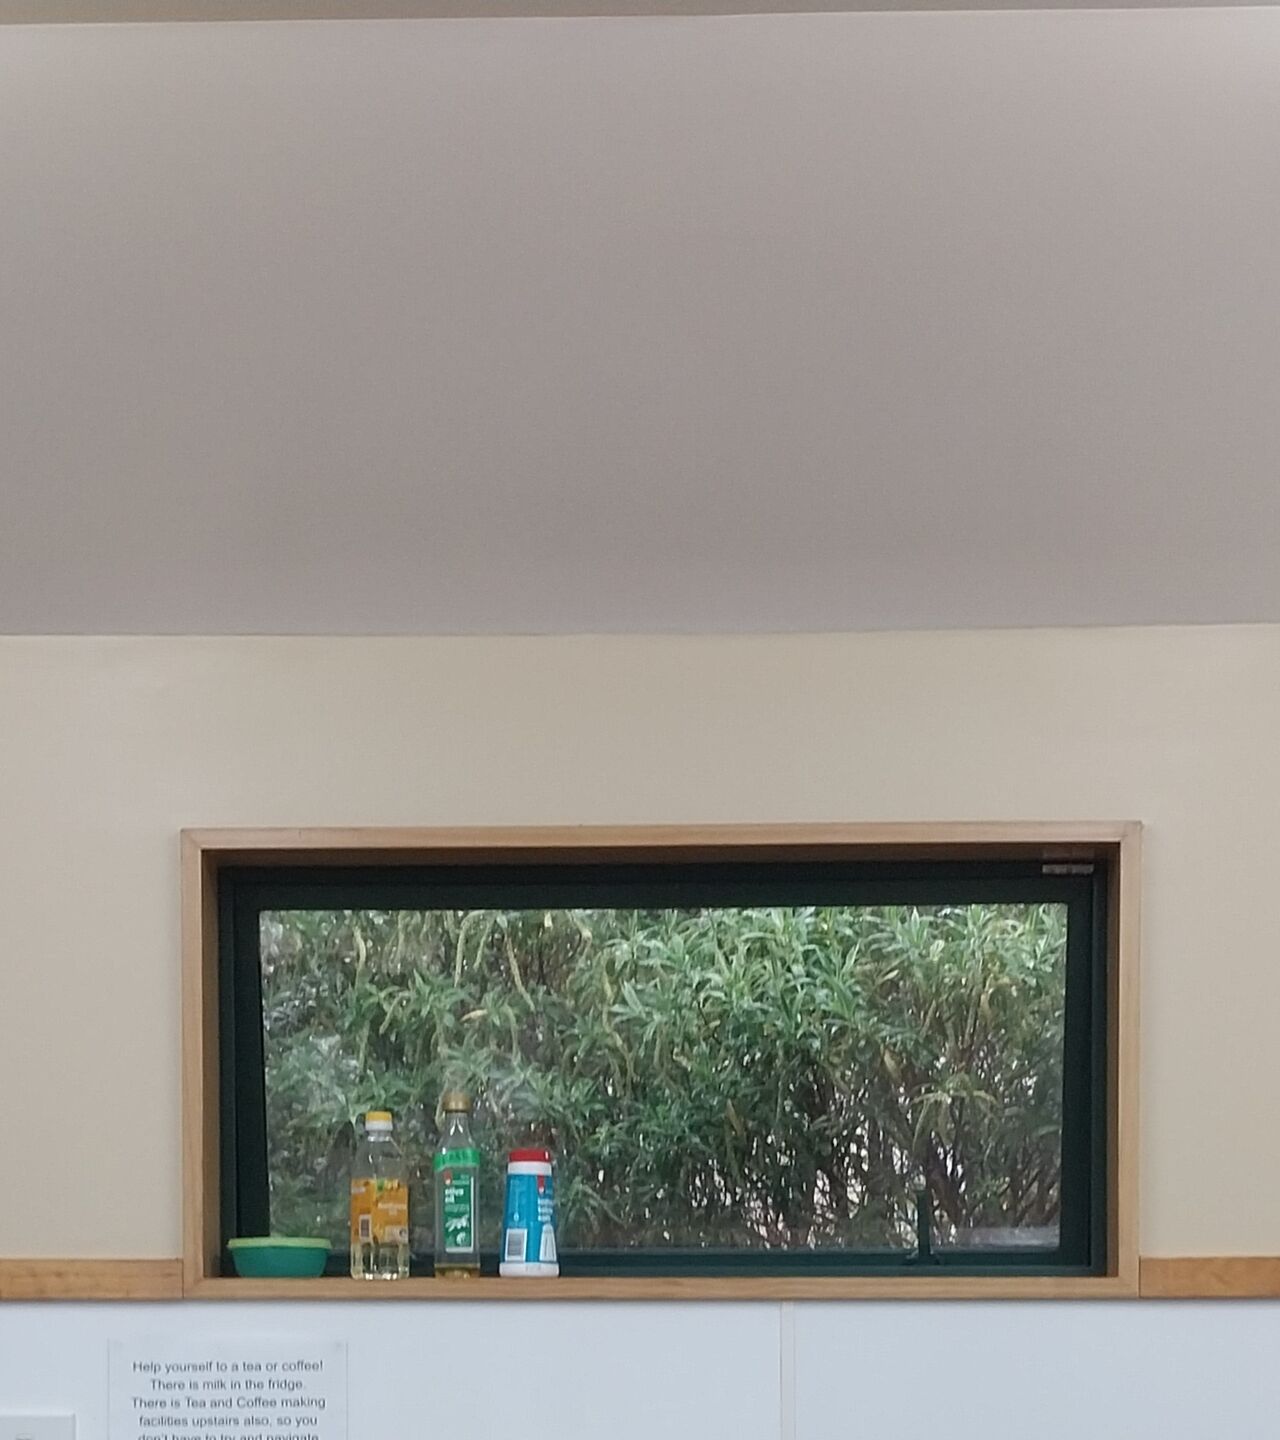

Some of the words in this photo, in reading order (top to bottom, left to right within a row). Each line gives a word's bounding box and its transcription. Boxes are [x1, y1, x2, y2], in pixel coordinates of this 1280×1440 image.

[132, 1360, 161, 1374] Help
[165, 1360, 212, 1374] yourself
[217, 1361, 228, 1372] to
[232, 1363, 239, 1372] a
[243, 1361, 262, 1372] tea
[266, 1362, 279, 1372] or
[282, 1360, 323, 1372] coffee!
[151, 1379, 185, 1391] There
[189, 1379, 199, 1391] is
[203, 1379, 227, 1391] milk
[231, 1379, 241, 1390] in
[245, 1379, 264, 1390] the
[132, 1397, 167, 1410] There
[171, 1397, 181, 1409] is
[185, 1397, 206, 1409] Tea
[210, 1397, 233, 1409] and
[237, 1396, 277, 1409] Coffee
[281, 1397, 326, 1410] making
[139, 1415, 188, 1428] facilities
[192, 1416, 240, 1429] upstairs
[244, 1415, 271, 1428] also,
[277, 1417, 291, 1427] so
[295, 1417, 317, 1429] you
